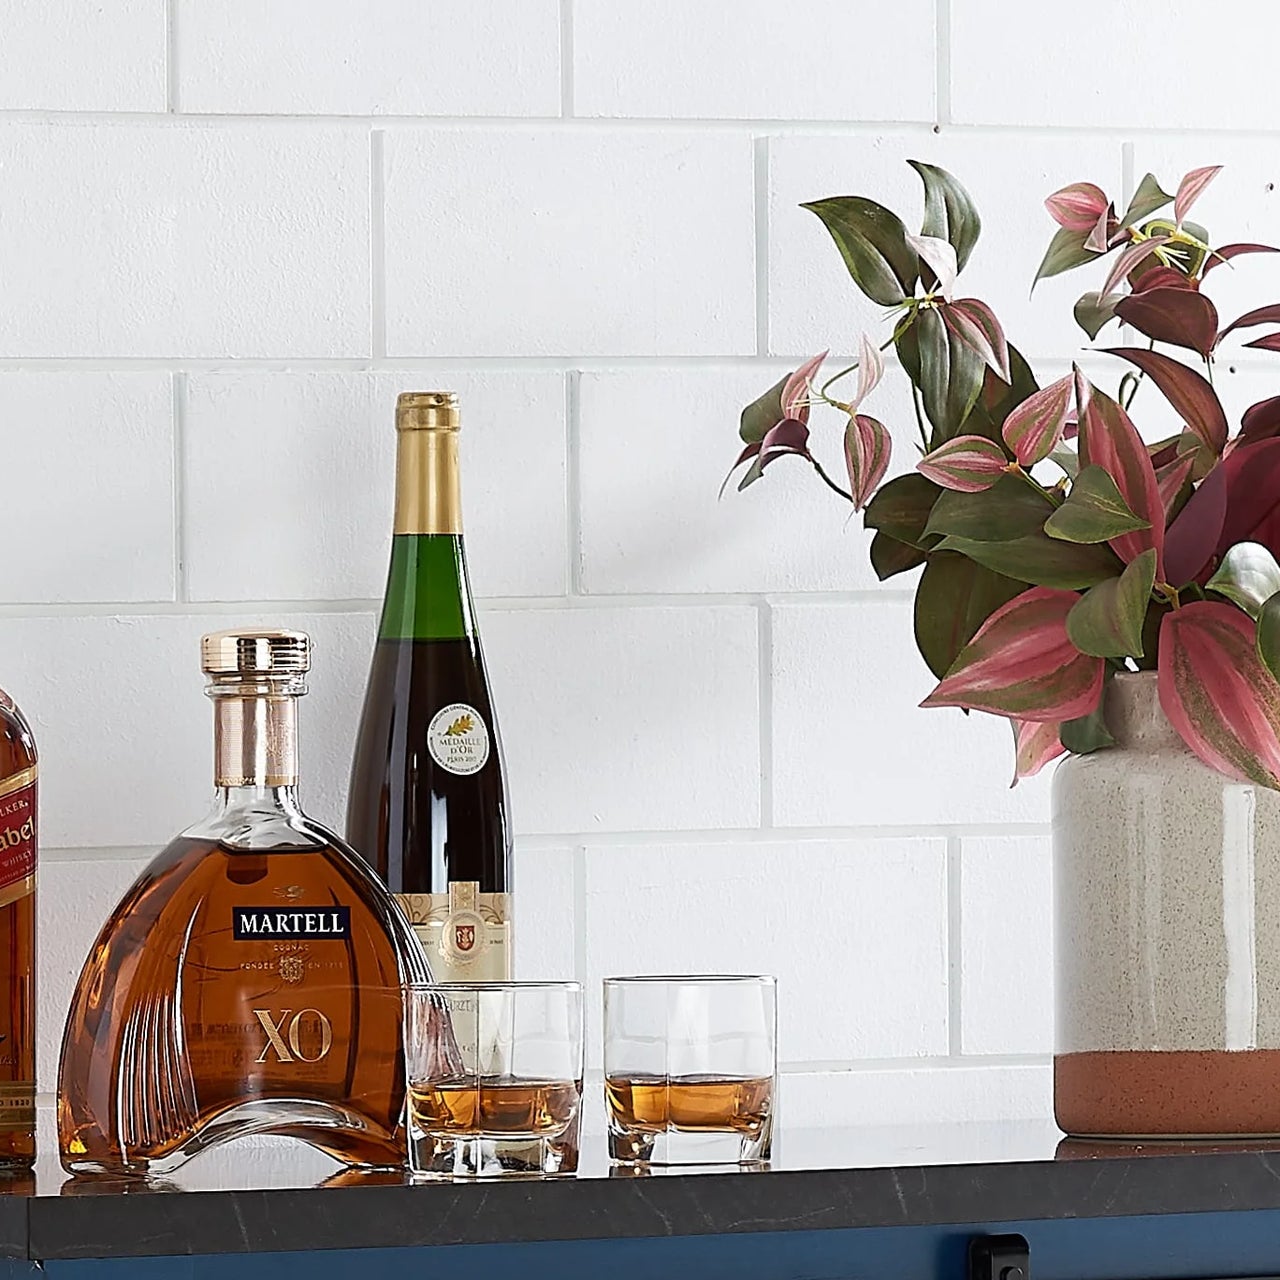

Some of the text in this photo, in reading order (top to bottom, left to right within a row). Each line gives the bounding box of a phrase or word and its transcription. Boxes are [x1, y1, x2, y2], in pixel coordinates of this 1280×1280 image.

[450, 745, 473, 754] D'OR
[240, 913, 345, 934] MARTELL
[273, 943, 310, 952] COGNAC
[253, 1008, 333, 1063] XO
[9, 1099, 31, 1107] 1820
